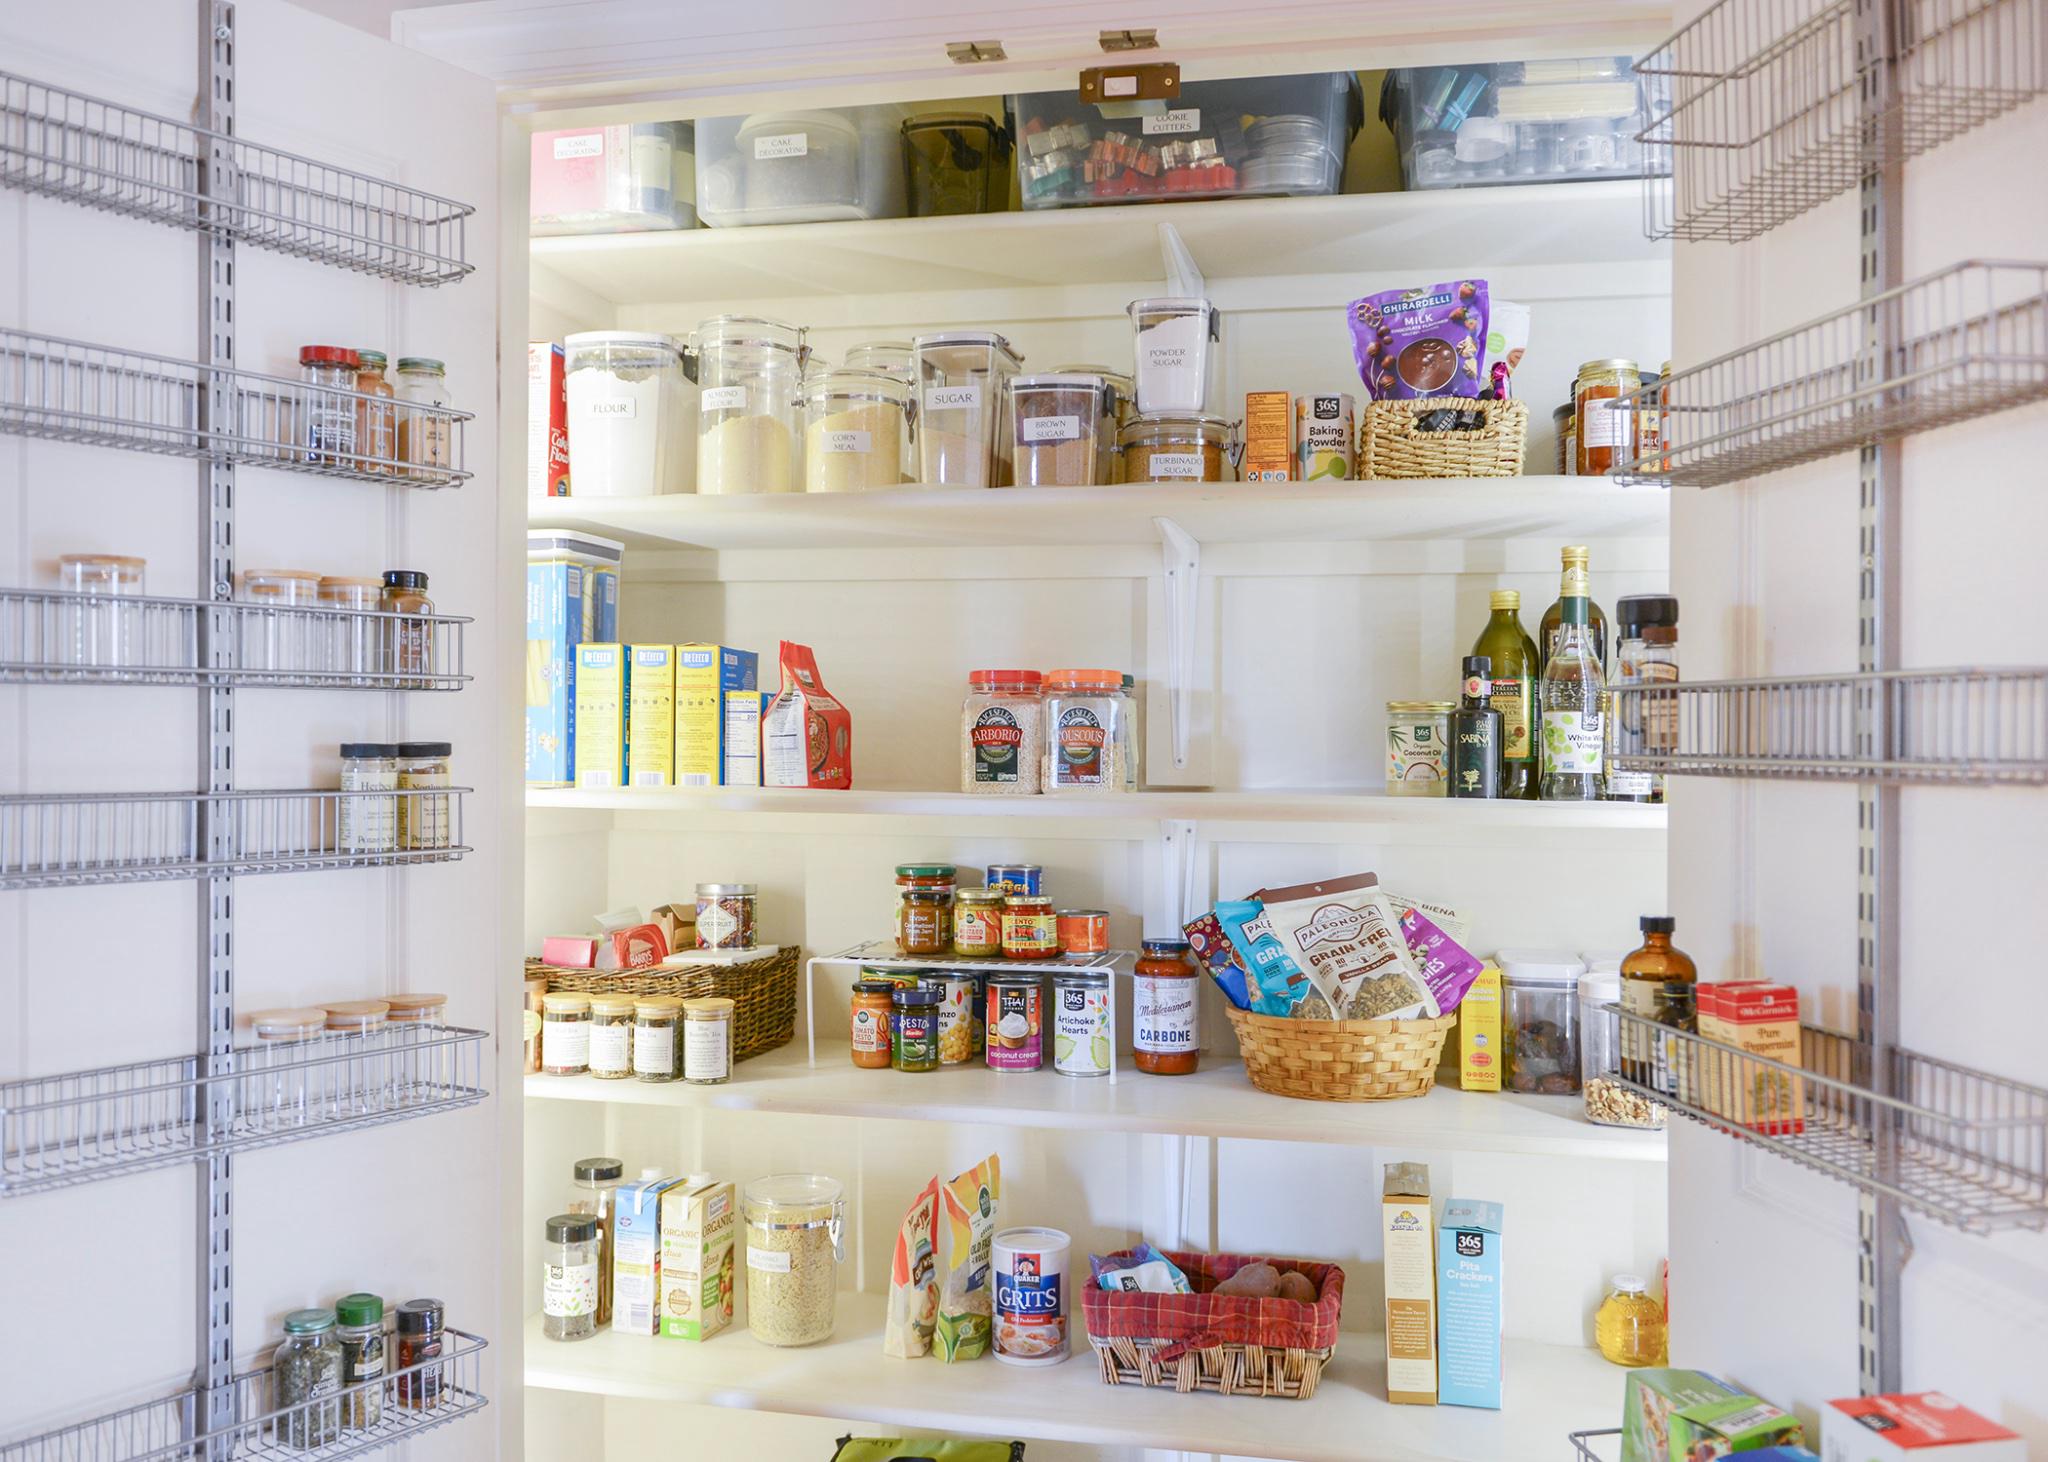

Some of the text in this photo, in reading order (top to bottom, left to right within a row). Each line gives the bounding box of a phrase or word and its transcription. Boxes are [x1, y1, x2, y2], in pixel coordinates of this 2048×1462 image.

[1153, 122, 1192, 131] CUTTERS
[771, 139, 791, 147] CAKE
[759, 147, 806, 157] DECORATING
[1383, 295, 1450, 314] GHIRARDELLI
[1404, 313, 1433, 326] MILK
[1150, 349, 1186, 358] POWDER
[1153, 358, 1182, 367] SUGAR
[708, 390, 738, 400] ALMOND
[934, 393, 973, 404] SUGAR
[593, 403, 628, 414] FLOUR
[1316, 400, 1337, 412] 365
[1035, 420, 1066, 429] BROWN
[832, 433, 856, 442] CORN
[1036, 429, 1065, 438] SUGAR
[1309, 426, 1344, 438] Baking
[833, 442, 856, 450] MEAL
[1307, 438, 1346, 448] Powder
[1155, 456, 1203, 466] TURBINADO
[1164, 465, 1193, 475] SUGAR
[979, 707, 1015, 724] RICESELECT
[1061, 707, 1097, 724] RICESELECT
[1583, 717, 1598, 726] 365
[973, 728, 1020, 742] ARBORIO
[1415, 729, 1430, 737] 365
[1460, 733, 1491, 744] SABINA
[1567, 734, 1593, 742] White
[988, 882, 1029, 893] ORTEGA
[1301, 910, 1376, 942] PALEONOLA
[1309, 944, 1356, 967] GRAIN
[1335, 957, 1346, 966] NO
[1001, 997, 1025, 1006] THAI
[1065, 992, 1083, 1004] 365
[1742, 1005, 1793, 1016] McCormick
[901, 1018, 927, 1029] PESTO
[1058, 1015, 1095, 1025] Artichoke
[1061, 1025, 1089, 1035] Hearts
[1140, 1028, 1191, 1042] CARBONE
[1757, 1028, 1780, 1039] Pure
[1743, 1040, 1796, 1053] Peppermint
[1018, 1051, 1039, 1059] cream
[702, 1212, 735, 1238] ORGANIC
[663, 1227, 699, 1239] ORGANIC
[1458, 1235, 1481, 1249] 365
[1460, 1260, 1480, 1271] Pita
[1013, 1275, 1040, 1283] QUAKER
[1446, 1269, 1494, 1282] Crackers
[998, 1286, 1057, 1310] GRITS
